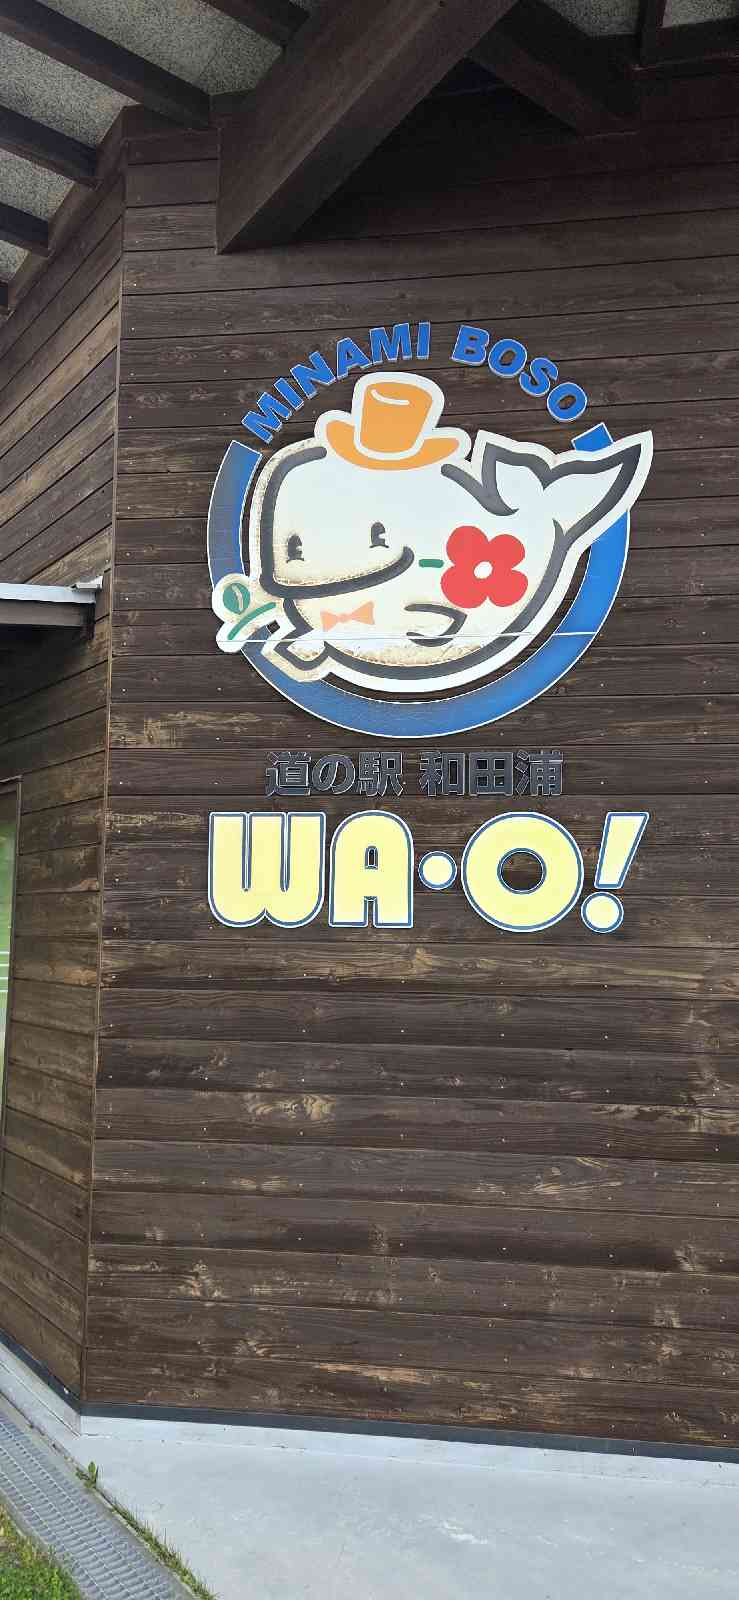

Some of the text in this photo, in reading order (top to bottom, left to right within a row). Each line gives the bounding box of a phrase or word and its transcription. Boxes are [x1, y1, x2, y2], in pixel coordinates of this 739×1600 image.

[241, 321, 588, 444] MINAMI BOSO
[265, 750, 564, 798] 道の駅 和田浦
